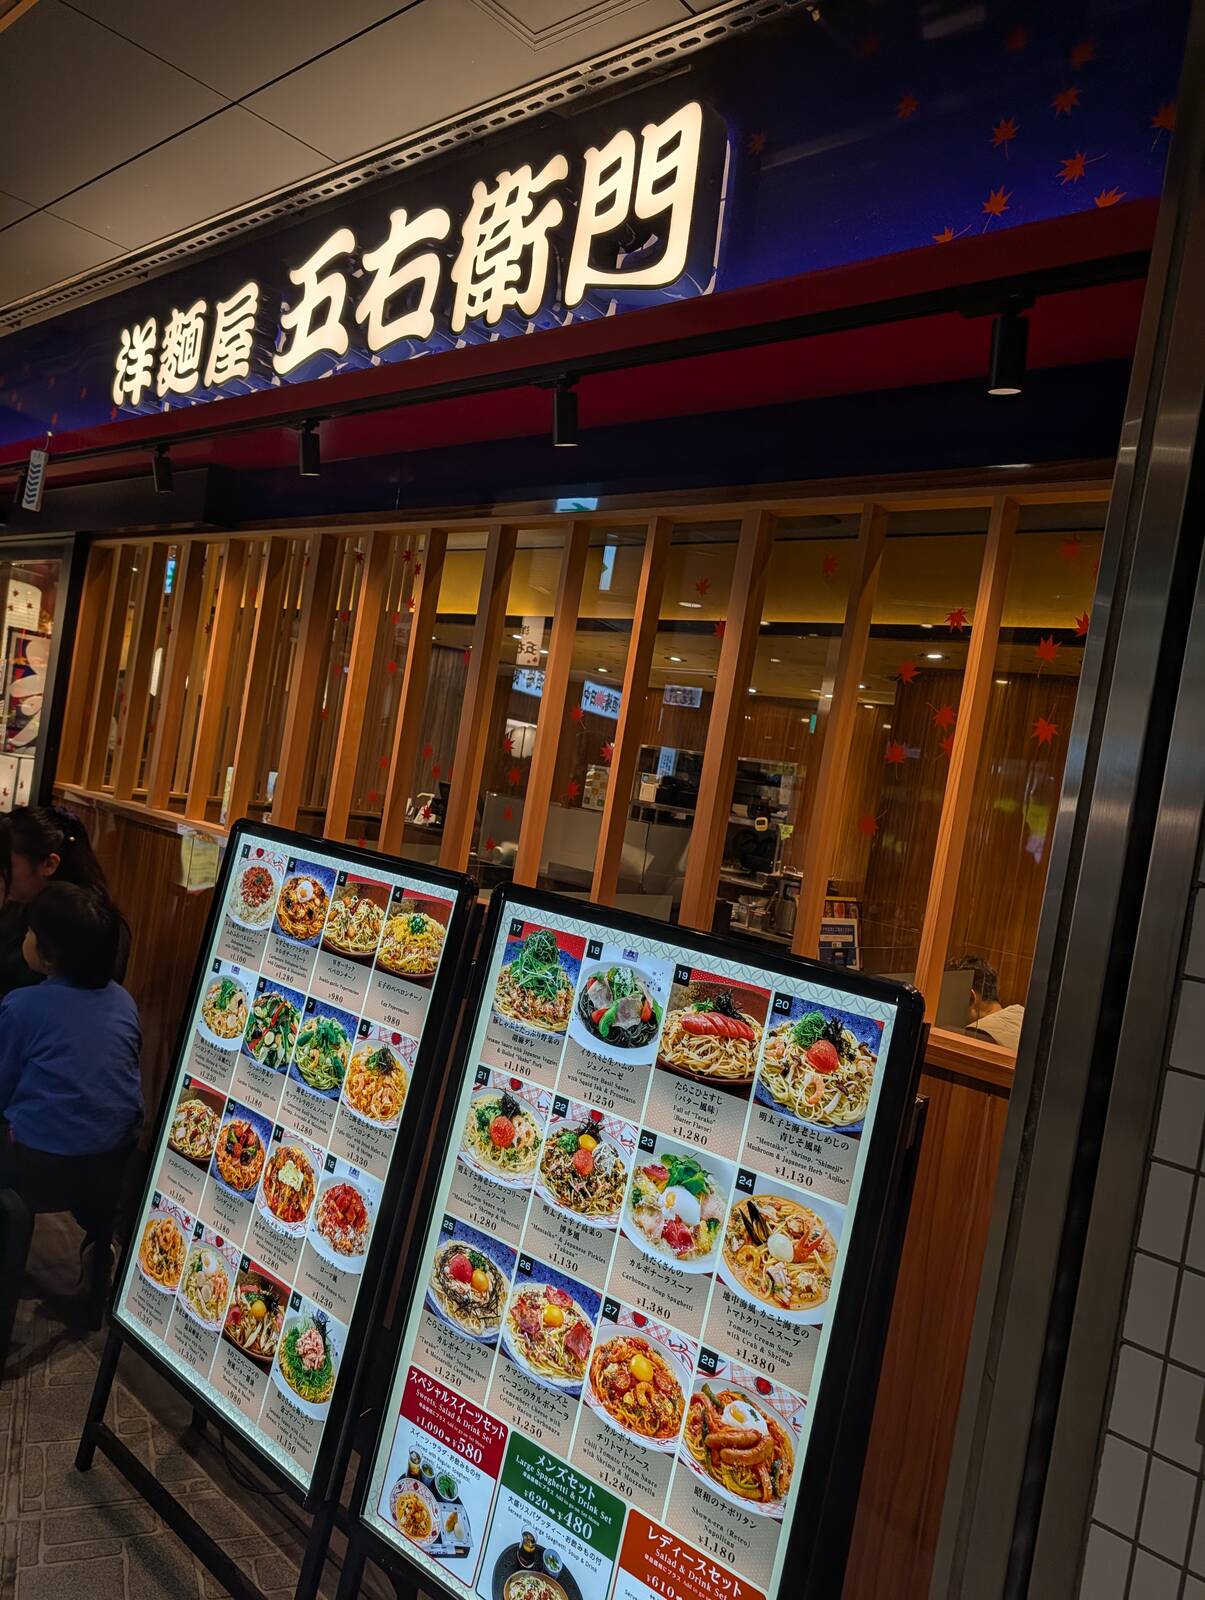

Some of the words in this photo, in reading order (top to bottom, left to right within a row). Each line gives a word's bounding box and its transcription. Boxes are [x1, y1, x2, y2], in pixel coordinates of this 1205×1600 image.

[272, 101, 703, 376] 五右衛門
[511, 923, 521, 932] 17
[590, 945, 600, 954] 18
[676, 970, 688, 980] 19
[327, 991, 343, 1003] ¥980
[775, 998, 789, 1009] 20
[383, 1013, 400, 1026] ¥980
[477, 1070, 486, 1080] 21
[503, 1059, 531, 1076] ¥1,180
[583, 1090, 614, 1109] ¥1,250
[674, 1080, 723, 1105] たらこひとすじ
[554, 1100, 566, 1112] 22
[292, 1120, 313, 1137] ¥1,280
[641, 1135, 653, 1147] 23
[672, 1124, 708, 1146] ¥1,280
[757, 1111, 850, 1151] 明太子と海老としめじの
[779, 1131, 823, 1155] 青じそ風味
[790, 1148, 813, 1163] Shrimp,
[346, 1150, 368, 1168] ¥1,330
[746, 1141, 774, 1158] Mushroom
[775, 1152, 780, 1160] &
[781, 1155, 807, 1170] Japanese
[807, 1165, 823, 1177] Herb
[738, 1174, 752, 1188] 24
[774, 1164, 813, 1187] ¥1,130
[472, 1182, 506, 1205] クリームソース
[443, 1219, 453, 1231] 25
[468, 1210, 497, 1232] ¥1,280
[559, 1223, 580, 1241] 博多風
[259, 1252, 279, 1271] ¥1,280
[519, 1258, 531, 1271] 26
[548, 1250, 578, 1273] ¥1,130
[641, 1251, 684, 1279] 具だくさんの
[628, 1257, 693, 1295] カルボナーラスープ
[312, 1289, 333, 1310] ¥1,230
[604, 1302, 617, 1316] 27
[636, 1295, 671, 1320] ¥1,380
[425, 1315, 488, 1360] たらことモッツァレラの
[725, 1304, 801, 1349] トマトクリームスープ
[727, 1319, 752, 1338] Tomato
[753, 1332, 775, 1349] Cream
[776, 1343, 793, 1358] Soup
[436, 1333, 472, 1362] カルボナーラ
[726, 1329, 740, 1342] with
[741, 1337, 758, 1351] Crab
[759, 1345, 765, 1355] &
[766, 1349, 791, 1368] Shrimp
[735, 1345, 775, 1374] ¥1,380
[701, 1353, 715, 1368] 28
[434, 1363, 462, 1388] ¥1,250
[504, 1362, 568, 1408] カマンベールチーズと
[226, 1388, 241, 1406] ¥980
[409, 1367, 506, 1442] スペシャルスイーツセット
[498, 1371, 569, 1422] ベーコンのカルボナーラ
[415, 1387, 437, 1408] Sweets,
[438, 1403, 455, 1420] Salad
[455, 1414, 461, 1424] &
[462, 1419, 481, 1437] Drink
[481, 1432, 492, 1445] Set
[512, 1412, 542, 1439] ¥1,250
[415, 1407, 446, 1440] ¥1,090
[450, 1432, 483, 1466] ¥580
[603, 1422, 647, 1456] カルボナーラ
[595, 1431, 650, 1472] チリトマトソース
[534, 1450, 597, 1503] メンズセット
[598, 1468, 633, 1498] ¥1,280
[514, 1454, 535, 1474] Large
[535, 1467, 568, 1497] Spaghetti
[569, 1490, 576, 1502] &
[577, 1495, 598, 1517] Drink
[599, 1510, 612, 1526] Set
[523, 1481, 549, 1512] ¥620
[556, 1504, 593, 1542] ¥480
[693, 1484, 757, 1532] 昭和のナポリタン
[697, 1532, 735, 1564] ¥1,180
[646, 1523, 743, 1600] レディースセット
[654, 1547, 677, 1570] Salad
[678, 1563, 686, 1576] &
[687, 1569, 712, 1593] Drink
[713, 1586, 727, 1600] Set
[646, 1570, 675, 1600] ¥610
